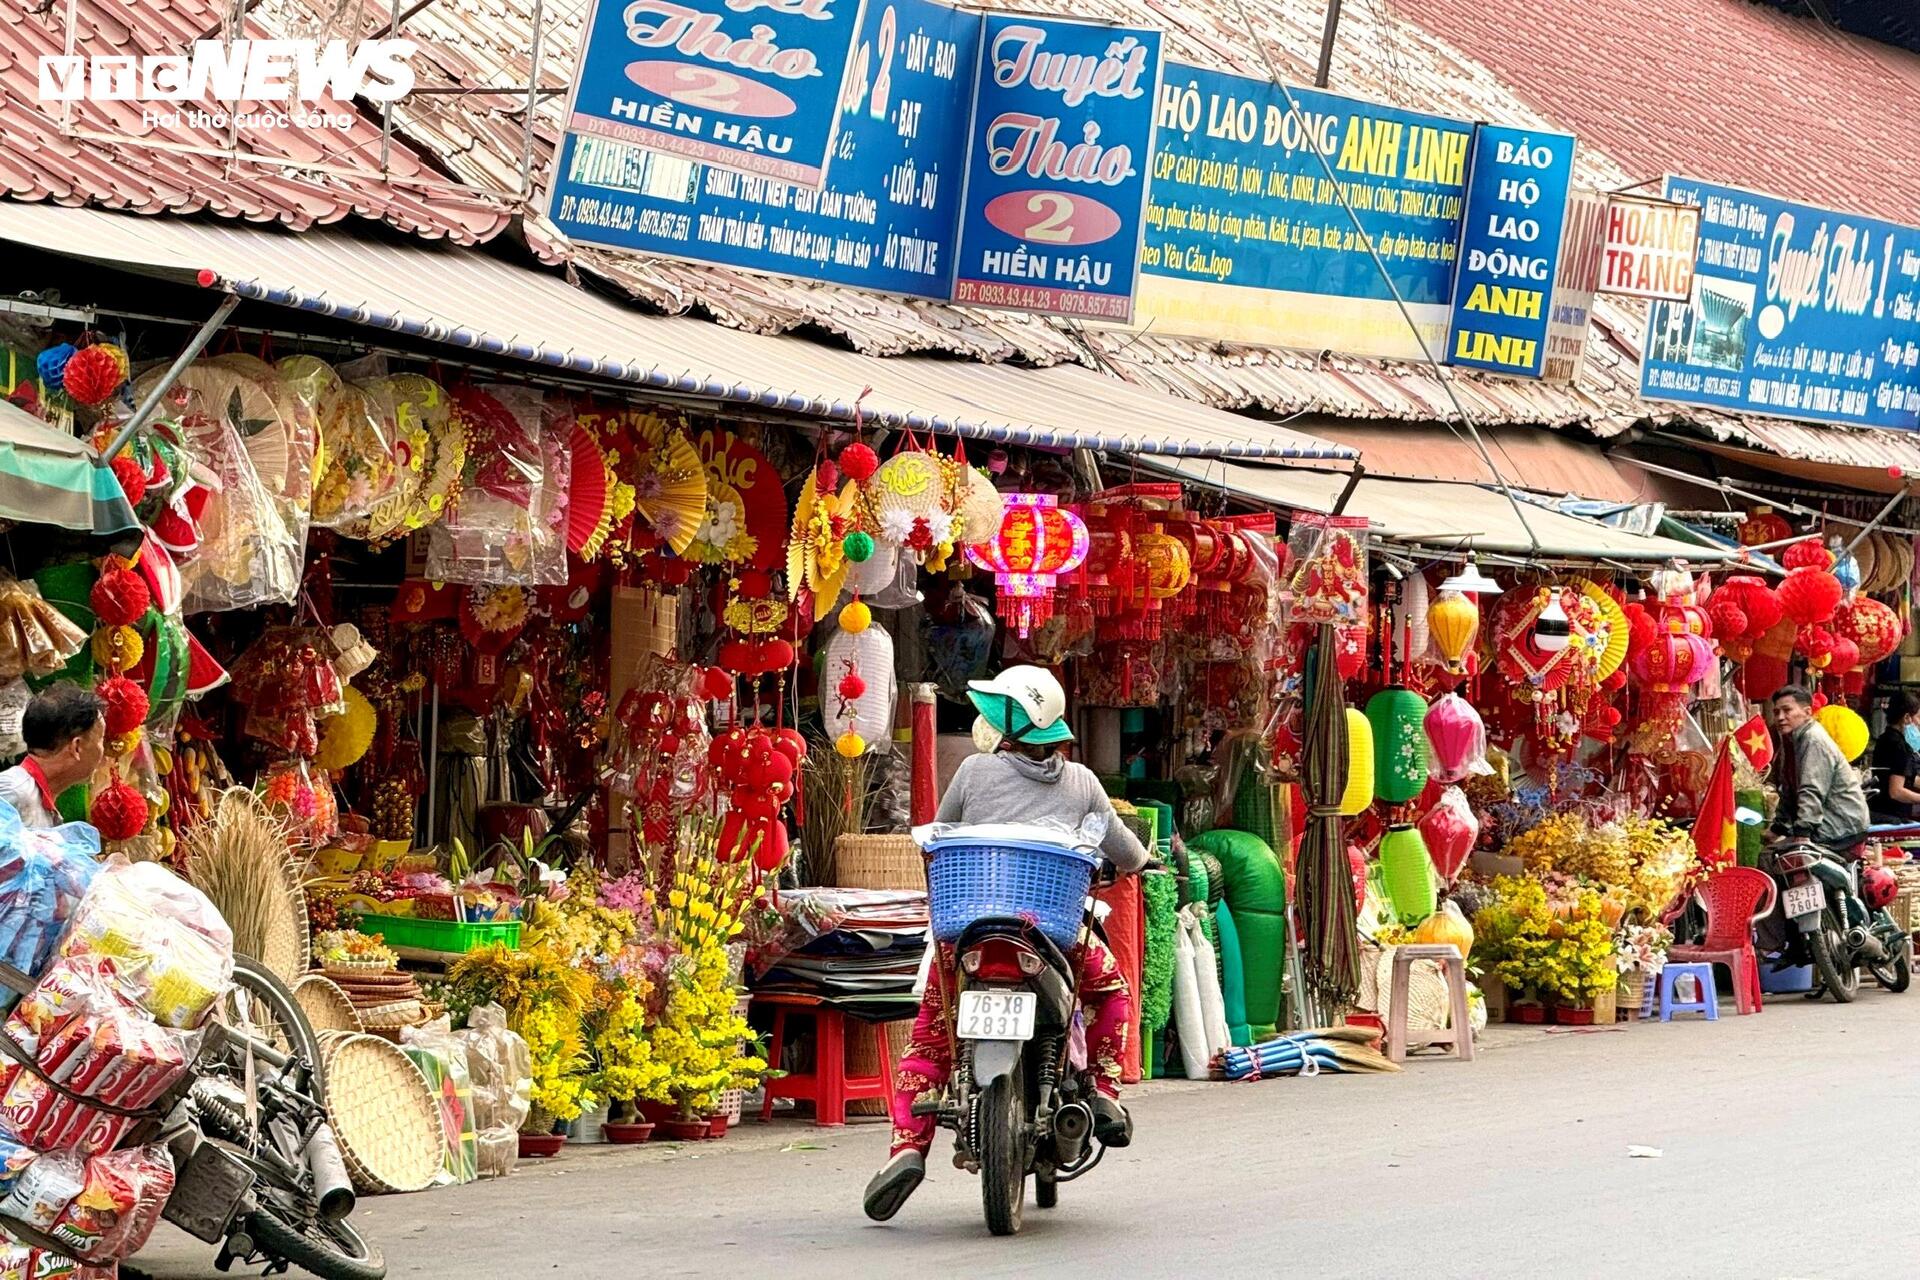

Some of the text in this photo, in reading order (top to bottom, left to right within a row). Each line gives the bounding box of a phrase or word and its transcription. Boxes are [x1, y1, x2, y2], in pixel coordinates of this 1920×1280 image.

[623, 0, 823, 79] Thảo
[906, 27, 956, 80] DÂY BAO
[870, 5, 896, 121] 2
[991, 25, 1148, 107] Tuyết
[671, 65, 742, 112] 2
[610, 97, 793, 154] HIỀN HẬU
[898, 99, 921, 148] BẠT
[1158, 80, 1469, 186] HỘ LAO ĐỘNG ANH LINH
[986, 112, 1136, 186] Thảo
[1200, 152, 1222, 188] BẢO
[1496, 137, 1553, 168] BẢO
[705, 168, 738, 198] SIMILI
[1498, 178, 1540, 209] HỘ
[576, 198, 635, 231] 0933.43.44.23
[1024, 193, 1075, 242] 2
[1488, 214, 1540, 242] LAO
[883, 223, 898, 268] ÁO
[923, 241, 938, 276] XE
[982, 244, 1112, 290] HIỀN HẬU
[1140, 239, 1161, 266] heo
[1468, 248, 1548, 280] ĐỘNG
[1606, 249, 1692, 294] TRANG
[1766, 212, 1894, 323] Tuyết Thảo 1
[979, 284, 1050, 309] 0933.43.44.23
[1059, 294, 1129, 318] 0978.857.551
[1463, 283, 1544, 320] ANH
[1455, 330, 1537, 368] LINH
[968, 1016, 1020, 1036] 2831
[971, 995, 1023, 1014] 76-X8
